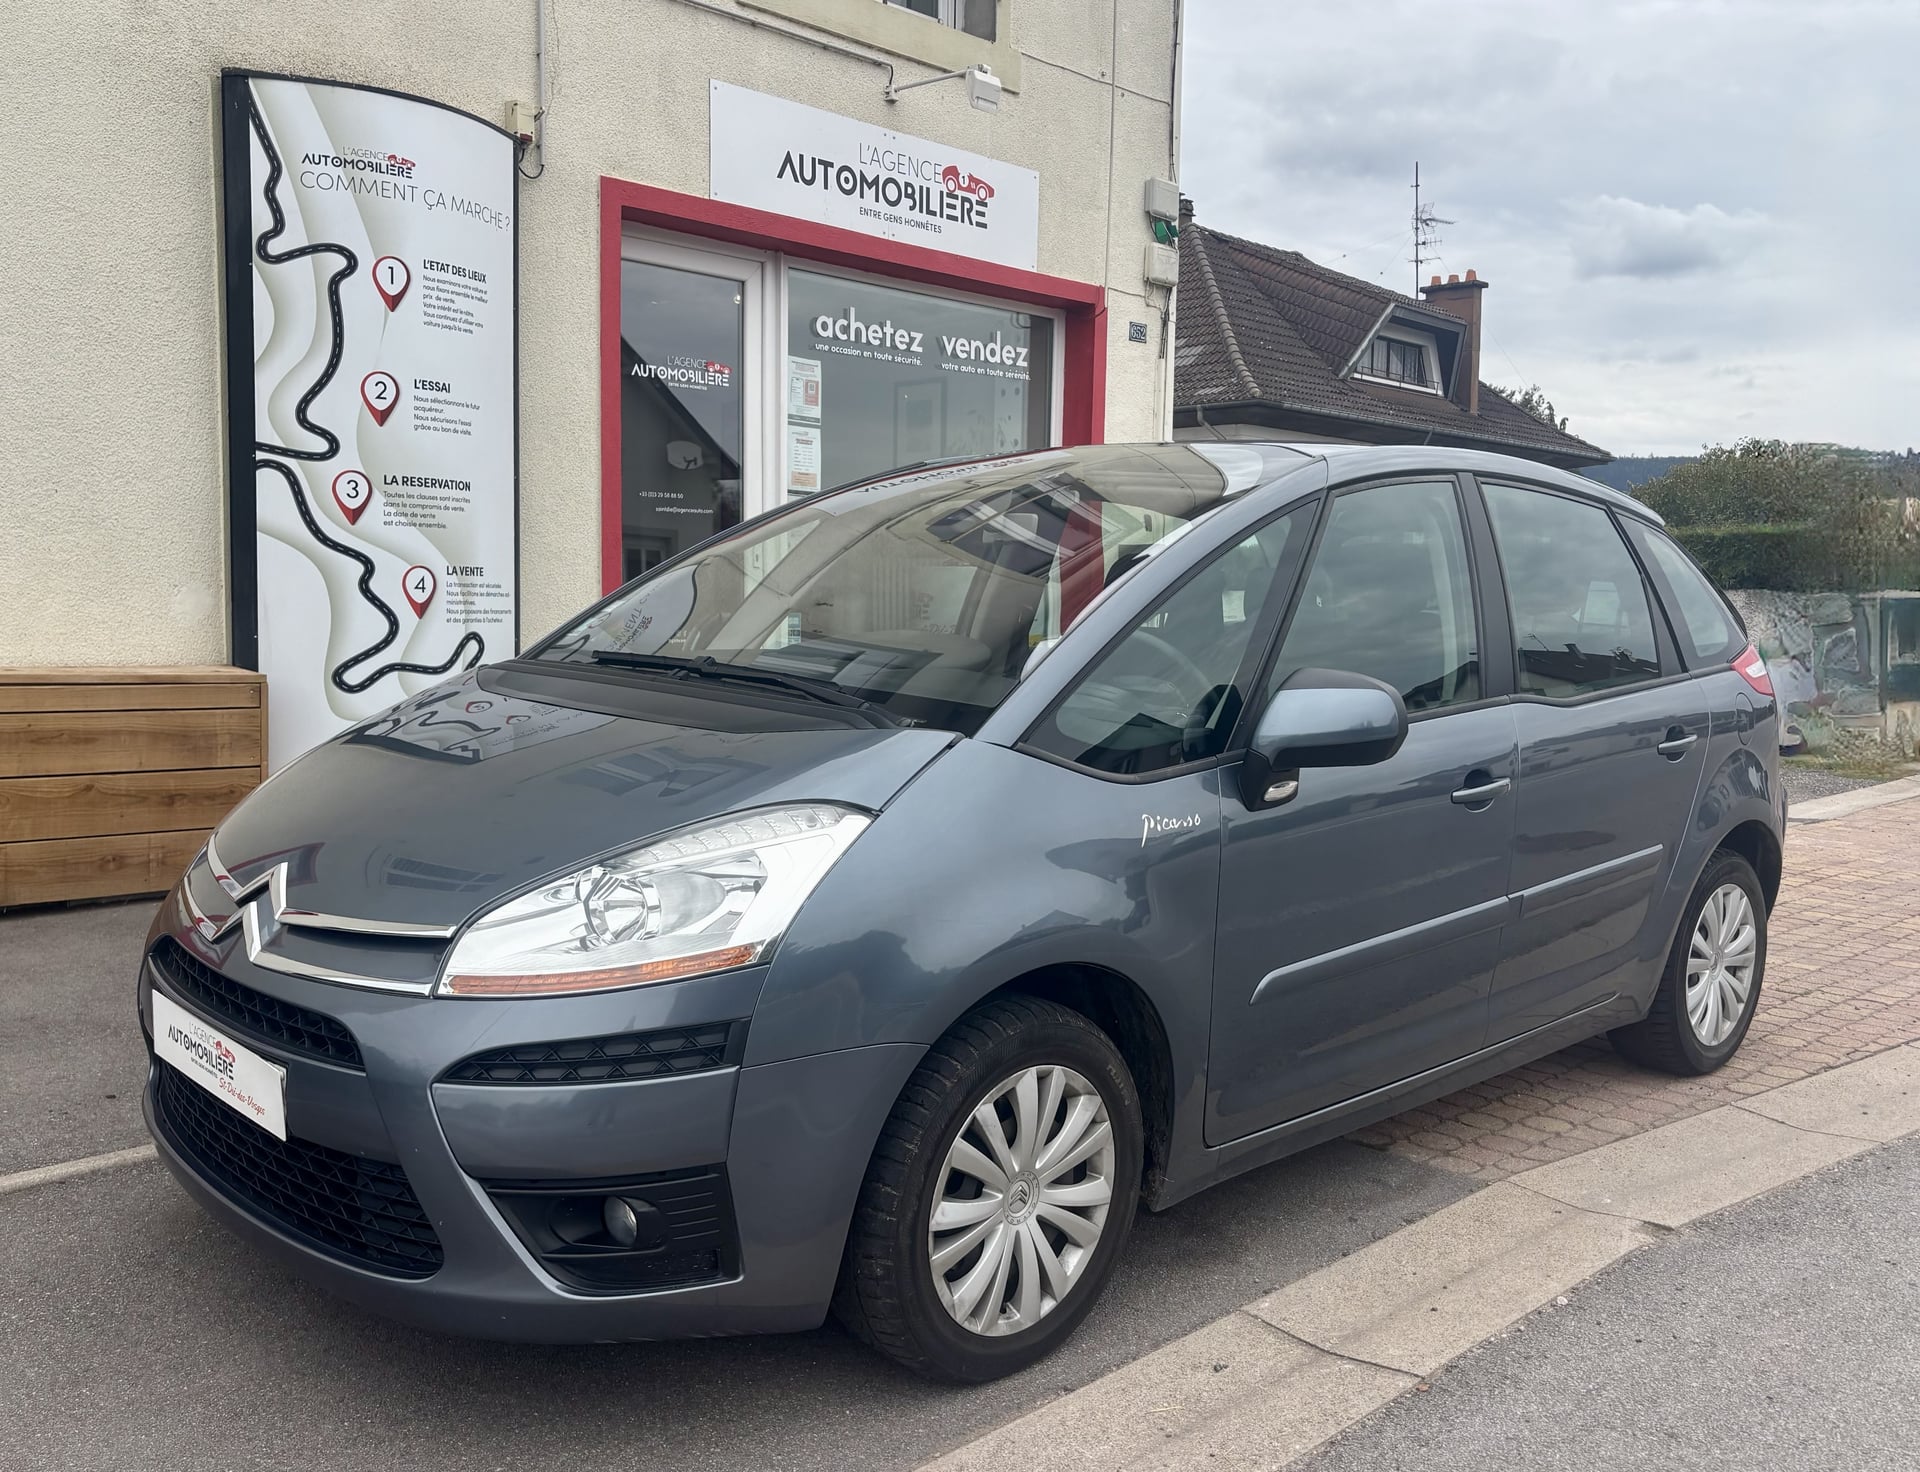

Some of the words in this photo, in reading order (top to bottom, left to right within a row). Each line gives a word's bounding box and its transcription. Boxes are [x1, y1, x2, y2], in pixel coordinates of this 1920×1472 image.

[342, 146, 388, 161] L'AGENCE
[859, 142, 942, 185] L'AGENCE
[300, 171, 419, 202] COMMENT
[423, 189, 447, 210] ÇA
[859, 206, 882, 220] ENTRE
[883, 213, 903, 225] GENS
[904, 217, 942, 234] HONNÊTES
[387, 266, 395, 285] 1
[422, 274, 436, 283] Nous
[423, 259, 451, 273] L'ETAT
[451, 265, 467, 278] DES
[467, 269, 487, 284] LIEUX
[816, 307, 924, 353] achetez
[1132, 325, 1146, 340] 652
[815, 343, 829, 352] une
[831, 346, 861, 357] occasion
[863, 350, 872, 358] en
[874, 351, 893, 361] toute
[894, 353, 923, 367] sécurité.
[942, 331, 1029, 368] vendez
[667, 355, 706, 369] L'AGENCE
[941, 362, 959, 371] votre
[960, 365, 976, 373] auto
[976, 367, 985, 375] en
[986, 367, 1004, 377] toute
[1005, 369, 1032, 381] sérénité.
[374, 380, 388, 401] 2
[414, 378, 451, 394] L'ESSAI
[413, 394, 429, 403] Nous
[413, 413, 429, 422] Nous
[413, 423, 431, 431] grâce
[440, 425, 452, 433] bon
[346, 479, 360, 499] 3
[383, 474, 399, 486] LA
[401, 475, 471, 492] RESERVATION
[383, 490, 405, 499] Toutes
[405, 491, 415, 500] les
[416, 492, 438, 501] clauses
[383, 500, 400, 508] dans
[408, 502, 442, 511] compromis
[392, 510, 409, 518] date
[446, 565, 458, 576] LA
[459, 565, 484, 577] VENTE
[413, 575, 427, 594] 4
